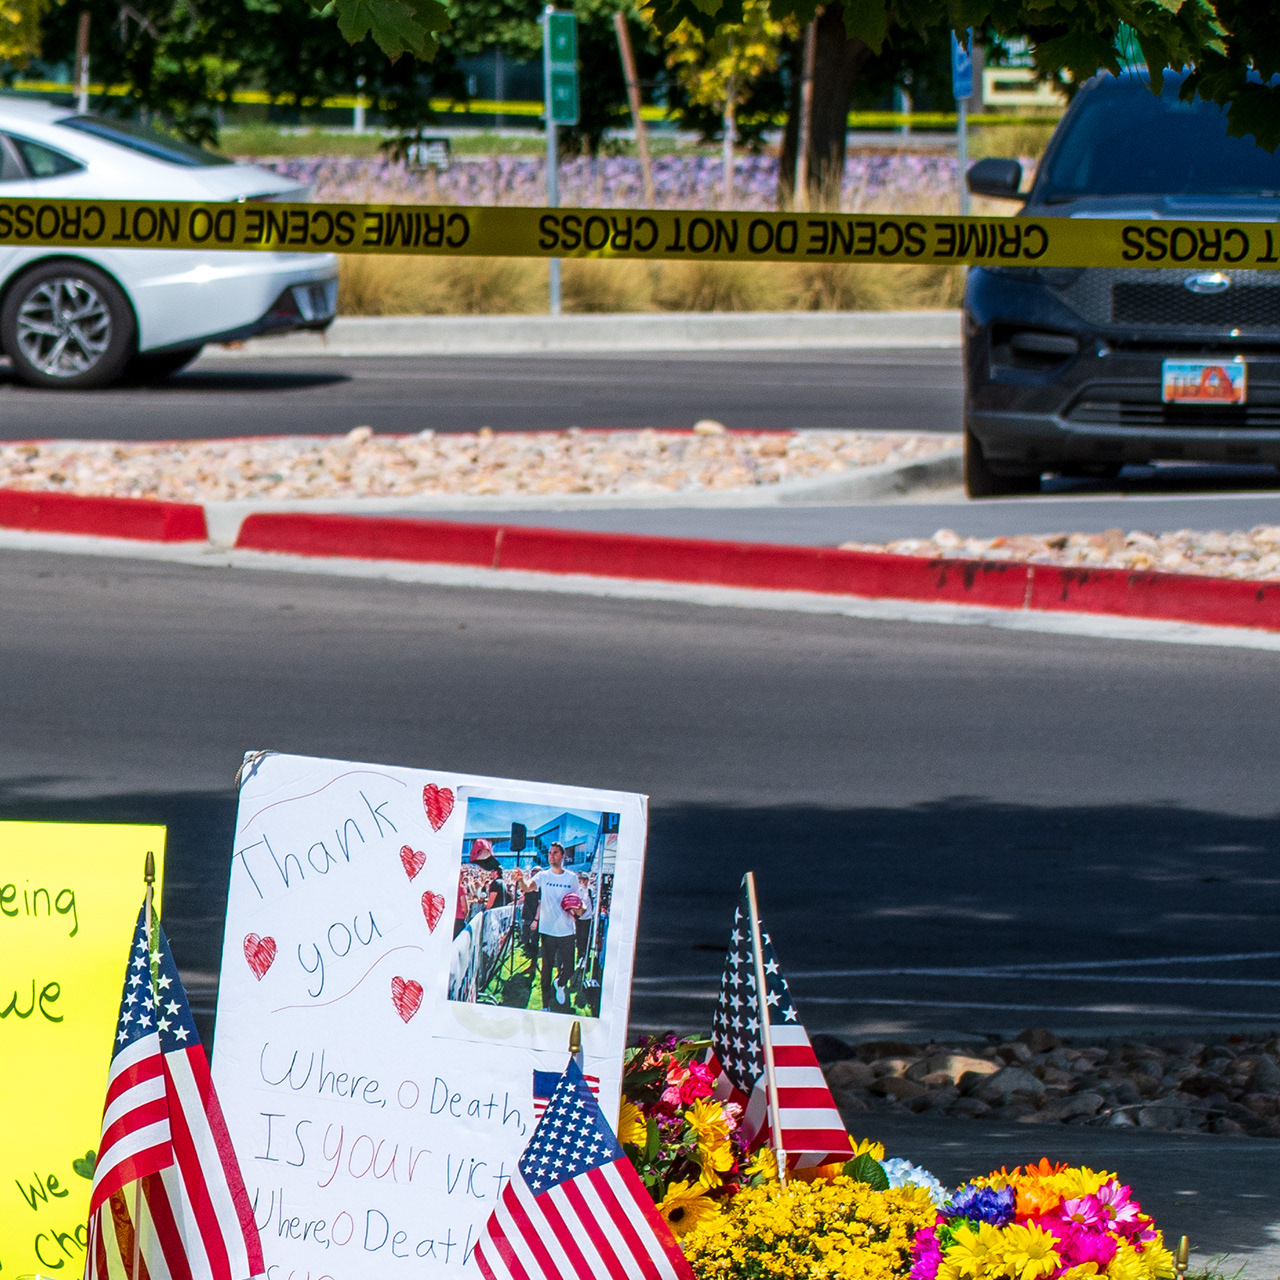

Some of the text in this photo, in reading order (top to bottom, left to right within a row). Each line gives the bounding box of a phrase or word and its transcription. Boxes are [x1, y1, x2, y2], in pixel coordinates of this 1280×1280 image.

[112, 207, 180, 241] NOT
[189, 208, 236, 243] DO
[244, 209, 356, 246] SCENE
[363, 212, 470, 248] CRIME
[539, 214, 1048, 258] CRIME SCENE DO NOT CROSS
[1123, 226, 1249, 262] CROSS
[233, 790, 399, 900] Thank
[297, 910, 383, 998] you
[260, 1042, 387, 1109] Where,
[430, 1079, 527, 1136] Death,
[317, 1123, 432, 1188] your
[15, 1171, 69, 1211] We
